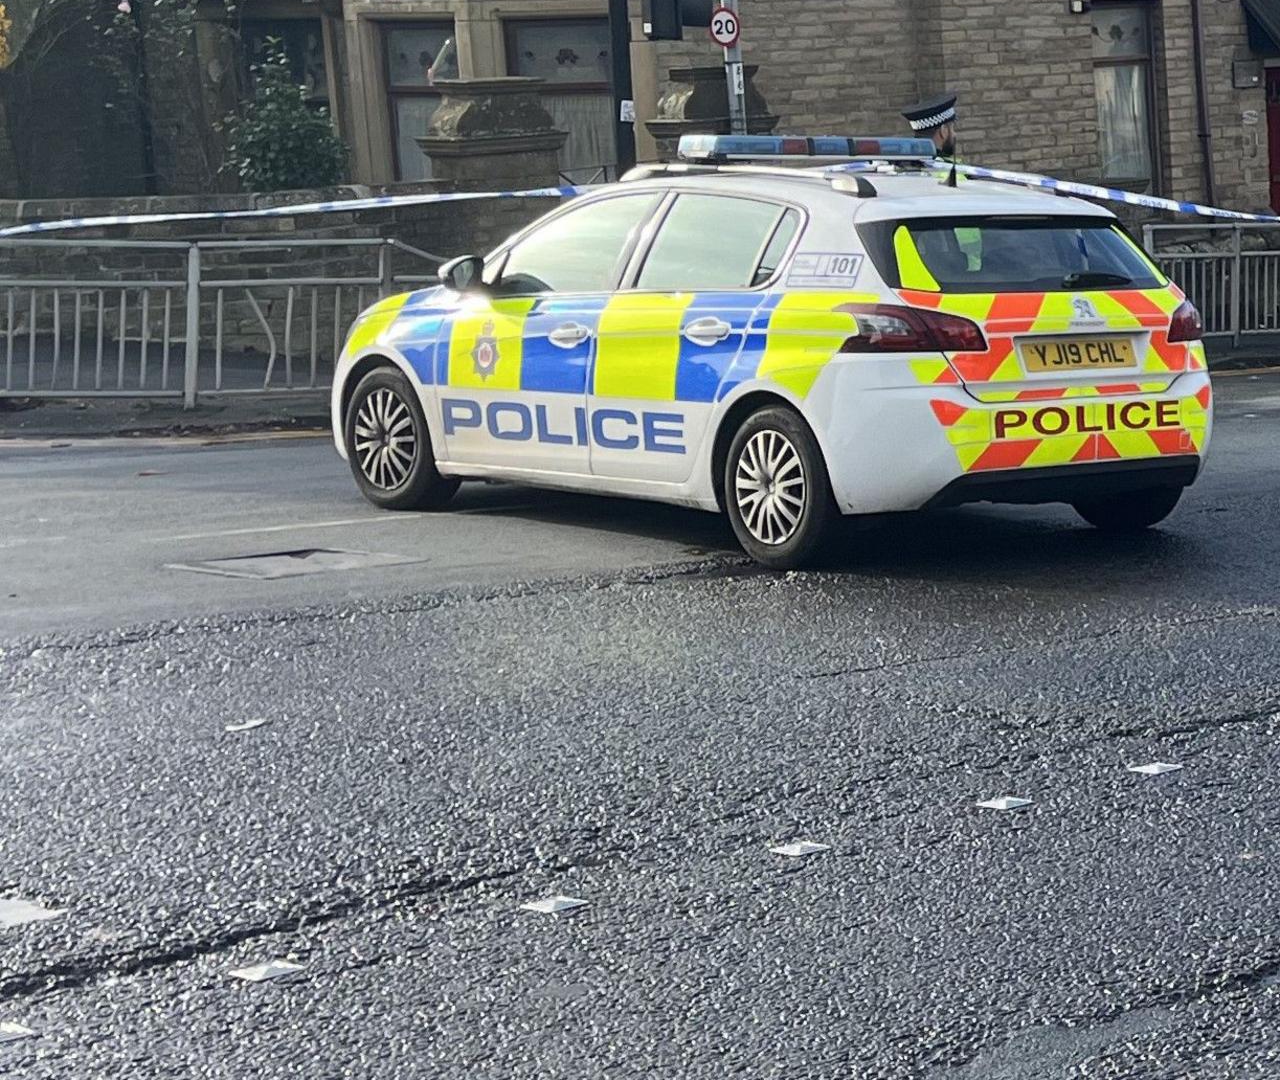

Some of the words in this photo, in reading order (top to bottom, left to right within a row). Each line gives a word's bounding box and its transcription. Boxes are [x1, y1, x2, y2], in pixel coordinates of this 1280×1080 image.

[714, 19, 735, 35] 20
[831, 257, 858, 275] 101
[1034, 343, 1082, 366] YJ19
[1086, 342, 1125, 363] CHL
[441, 398, 686, 455] POLICE
[994, 400, 1180, 439] POLICE
